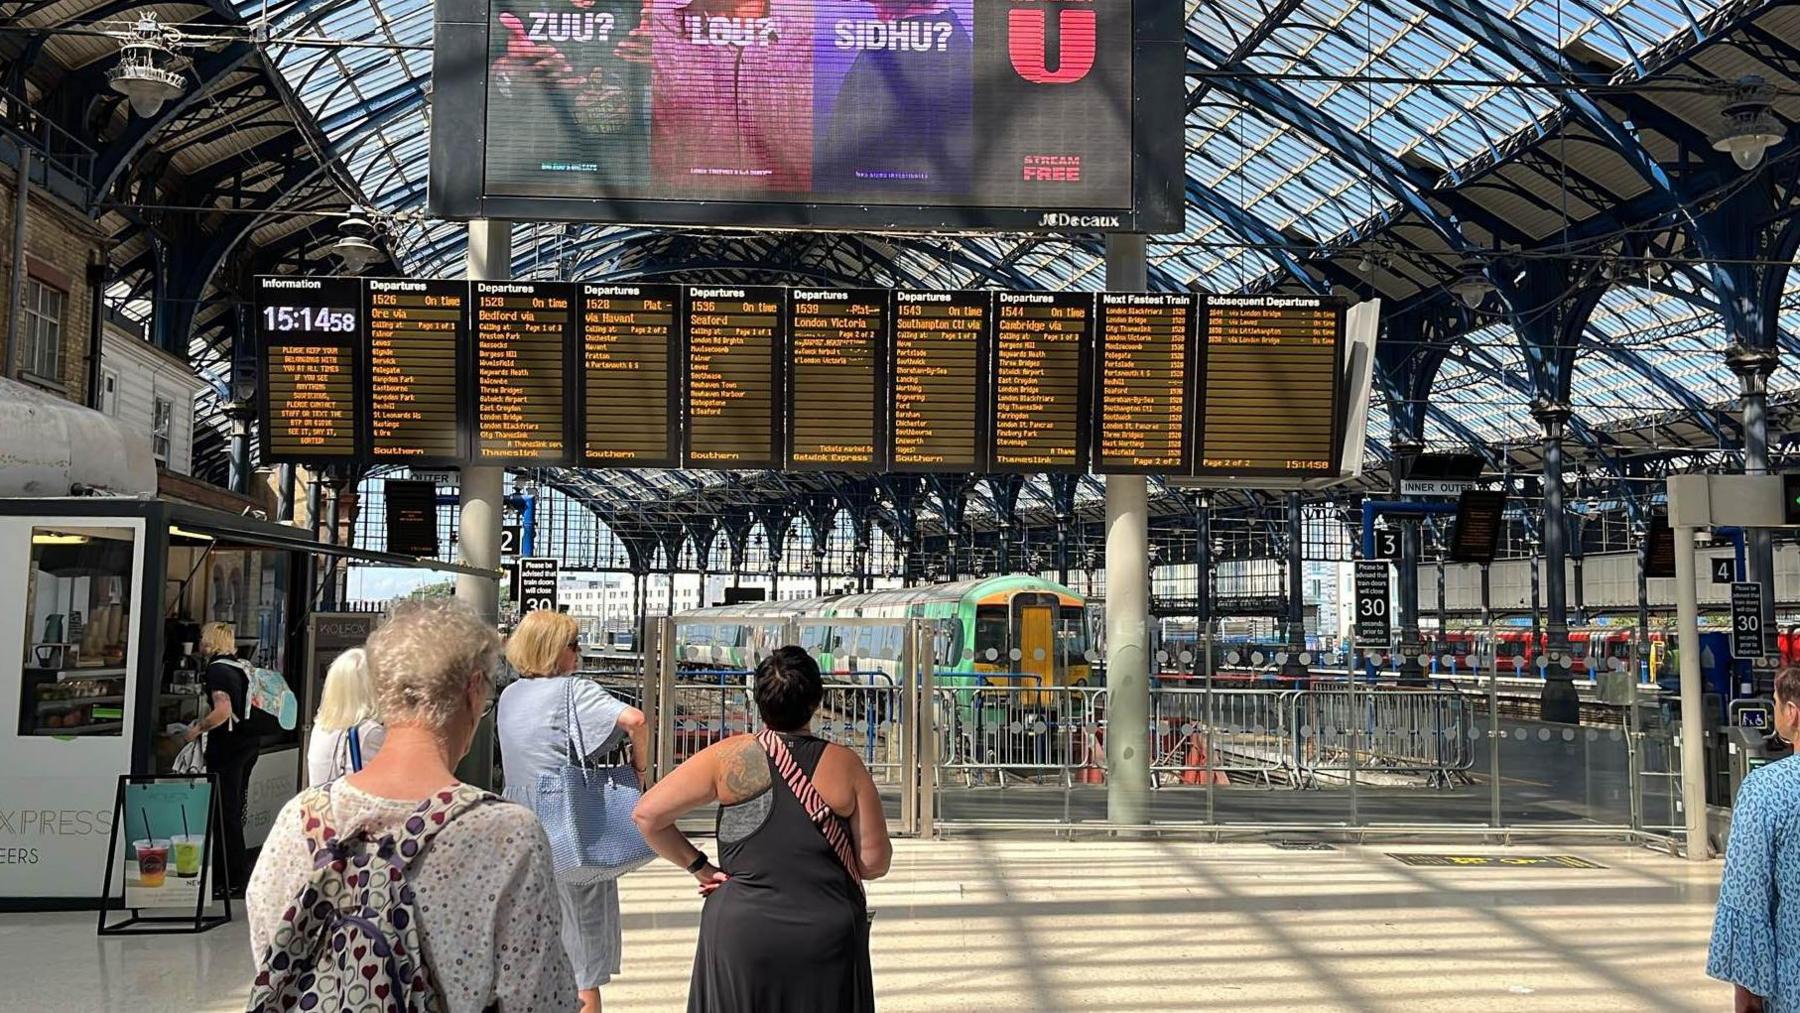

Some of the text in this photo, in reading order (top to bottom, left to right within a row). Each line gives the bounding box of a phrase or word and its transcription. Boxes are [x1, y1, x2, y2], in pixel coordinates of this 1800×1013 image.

[528, 12, 614, 42] ZUU?
[834, 19, 953, 51] SIDHU?
[1008, 9, 1096, 83] U
[1024, 155, 1080, 165] STREAM
[1024, 167, 1080, 181] FREE
[1038, 213, 1119, 227] JCDecaux
[263, 279, 321, 288] Information
[370, 281, 427, 291] Departures
[478, 283, 534, 293] Departures
[584, 285, 639, 296] Departures
[690, 288, 745, 298] Departures
[794, 290, 848, 301] Departures
[373, 295, 460, 306] 1526 On time
[480, 297, 567, 308] 1528 On time
[898, 292, 951, 303] Departures
[1000, 293, 1054, 304] Departures
[1103, 295, 1190, 304] Next Fastest Train
[1207, 297, 1320, 308] Subsequent Departures
[587, 299, 662, 310] 1528 Plat
[692, 301, 777, 312] 1536 On time
[796, 304, 819, 314] 1539
[372, 309, 407, 318] Ore via
[479, 311, 534, 321] Bedford via
[899, 306, 921, 315] 1543
[964, 307, 982, 316] time
[1002, 307, 1085, 318] 1544 On time
[585, 313, 634, 323] via Havant
[691, 315, 727, 325] Seaford
[795, 318, 866, 328] London Victoria
[897, 319, 949, 330] Southampton
[967, 321, 981, 329] via
[1000, 320, 1062, 331] Cambridge via
[831, 454, 868, 462] Express
[1203, 459, 1221, 467] Page
[1285, 460, 1329, 469] 15:14:58
[1405, 483, 1472, 492] INNER OUTER
[501, 531, 513, 551] 2
[1383, 535, 1395, 554] 3
[1718, 563, 1729, 580] 4
[527, 598, 551, 613] 30
[1361, 599, 1384, 616] 30
[1738, 616, 1758, 631] 30
[0, 810, 113, 835] XPRESS
